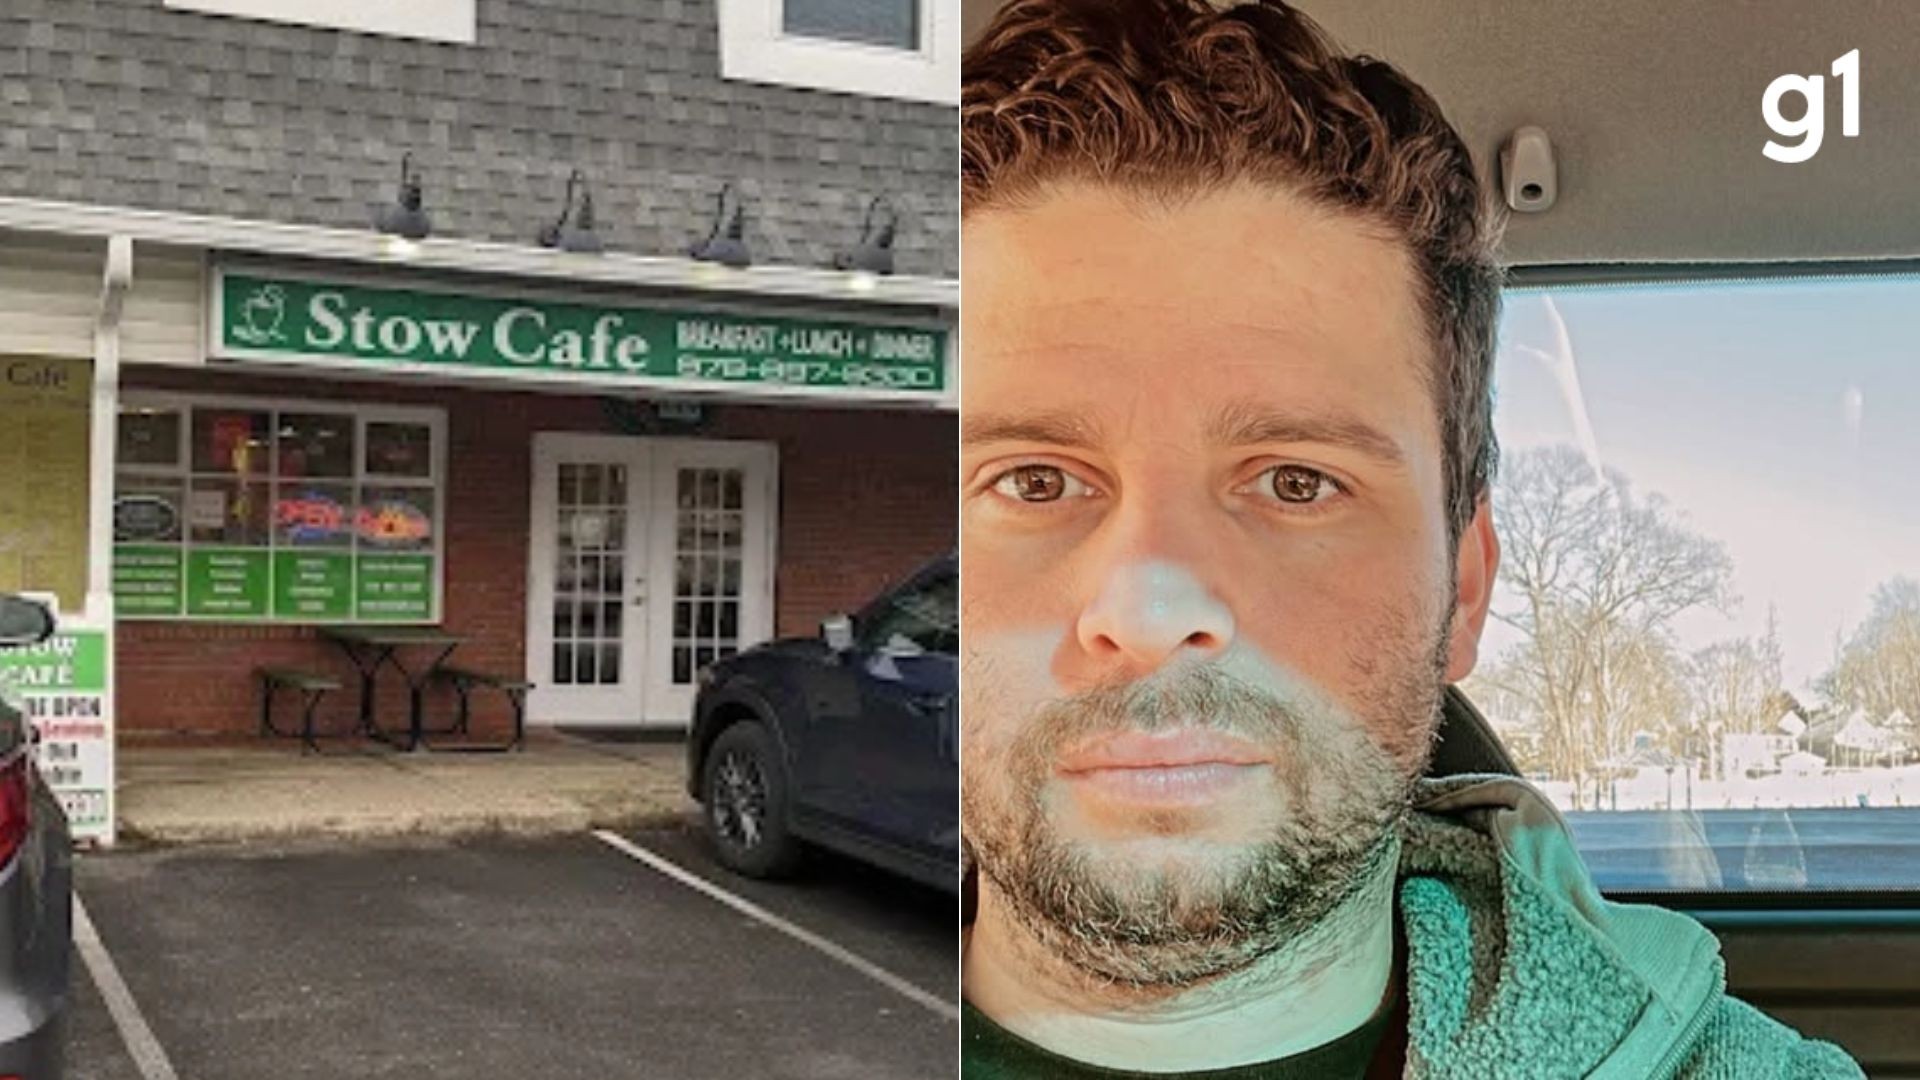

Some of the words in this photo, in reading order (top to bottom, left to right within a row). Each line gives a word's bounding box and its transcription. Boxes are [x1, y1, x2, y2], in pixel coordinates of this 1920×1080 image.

[304, 292, 481, 359] Stow
[492, 307, 651, 371] Cafe
[676, 320, 779, 355] BREAKFAST
[790, 328, 853, 357] LUNCH
